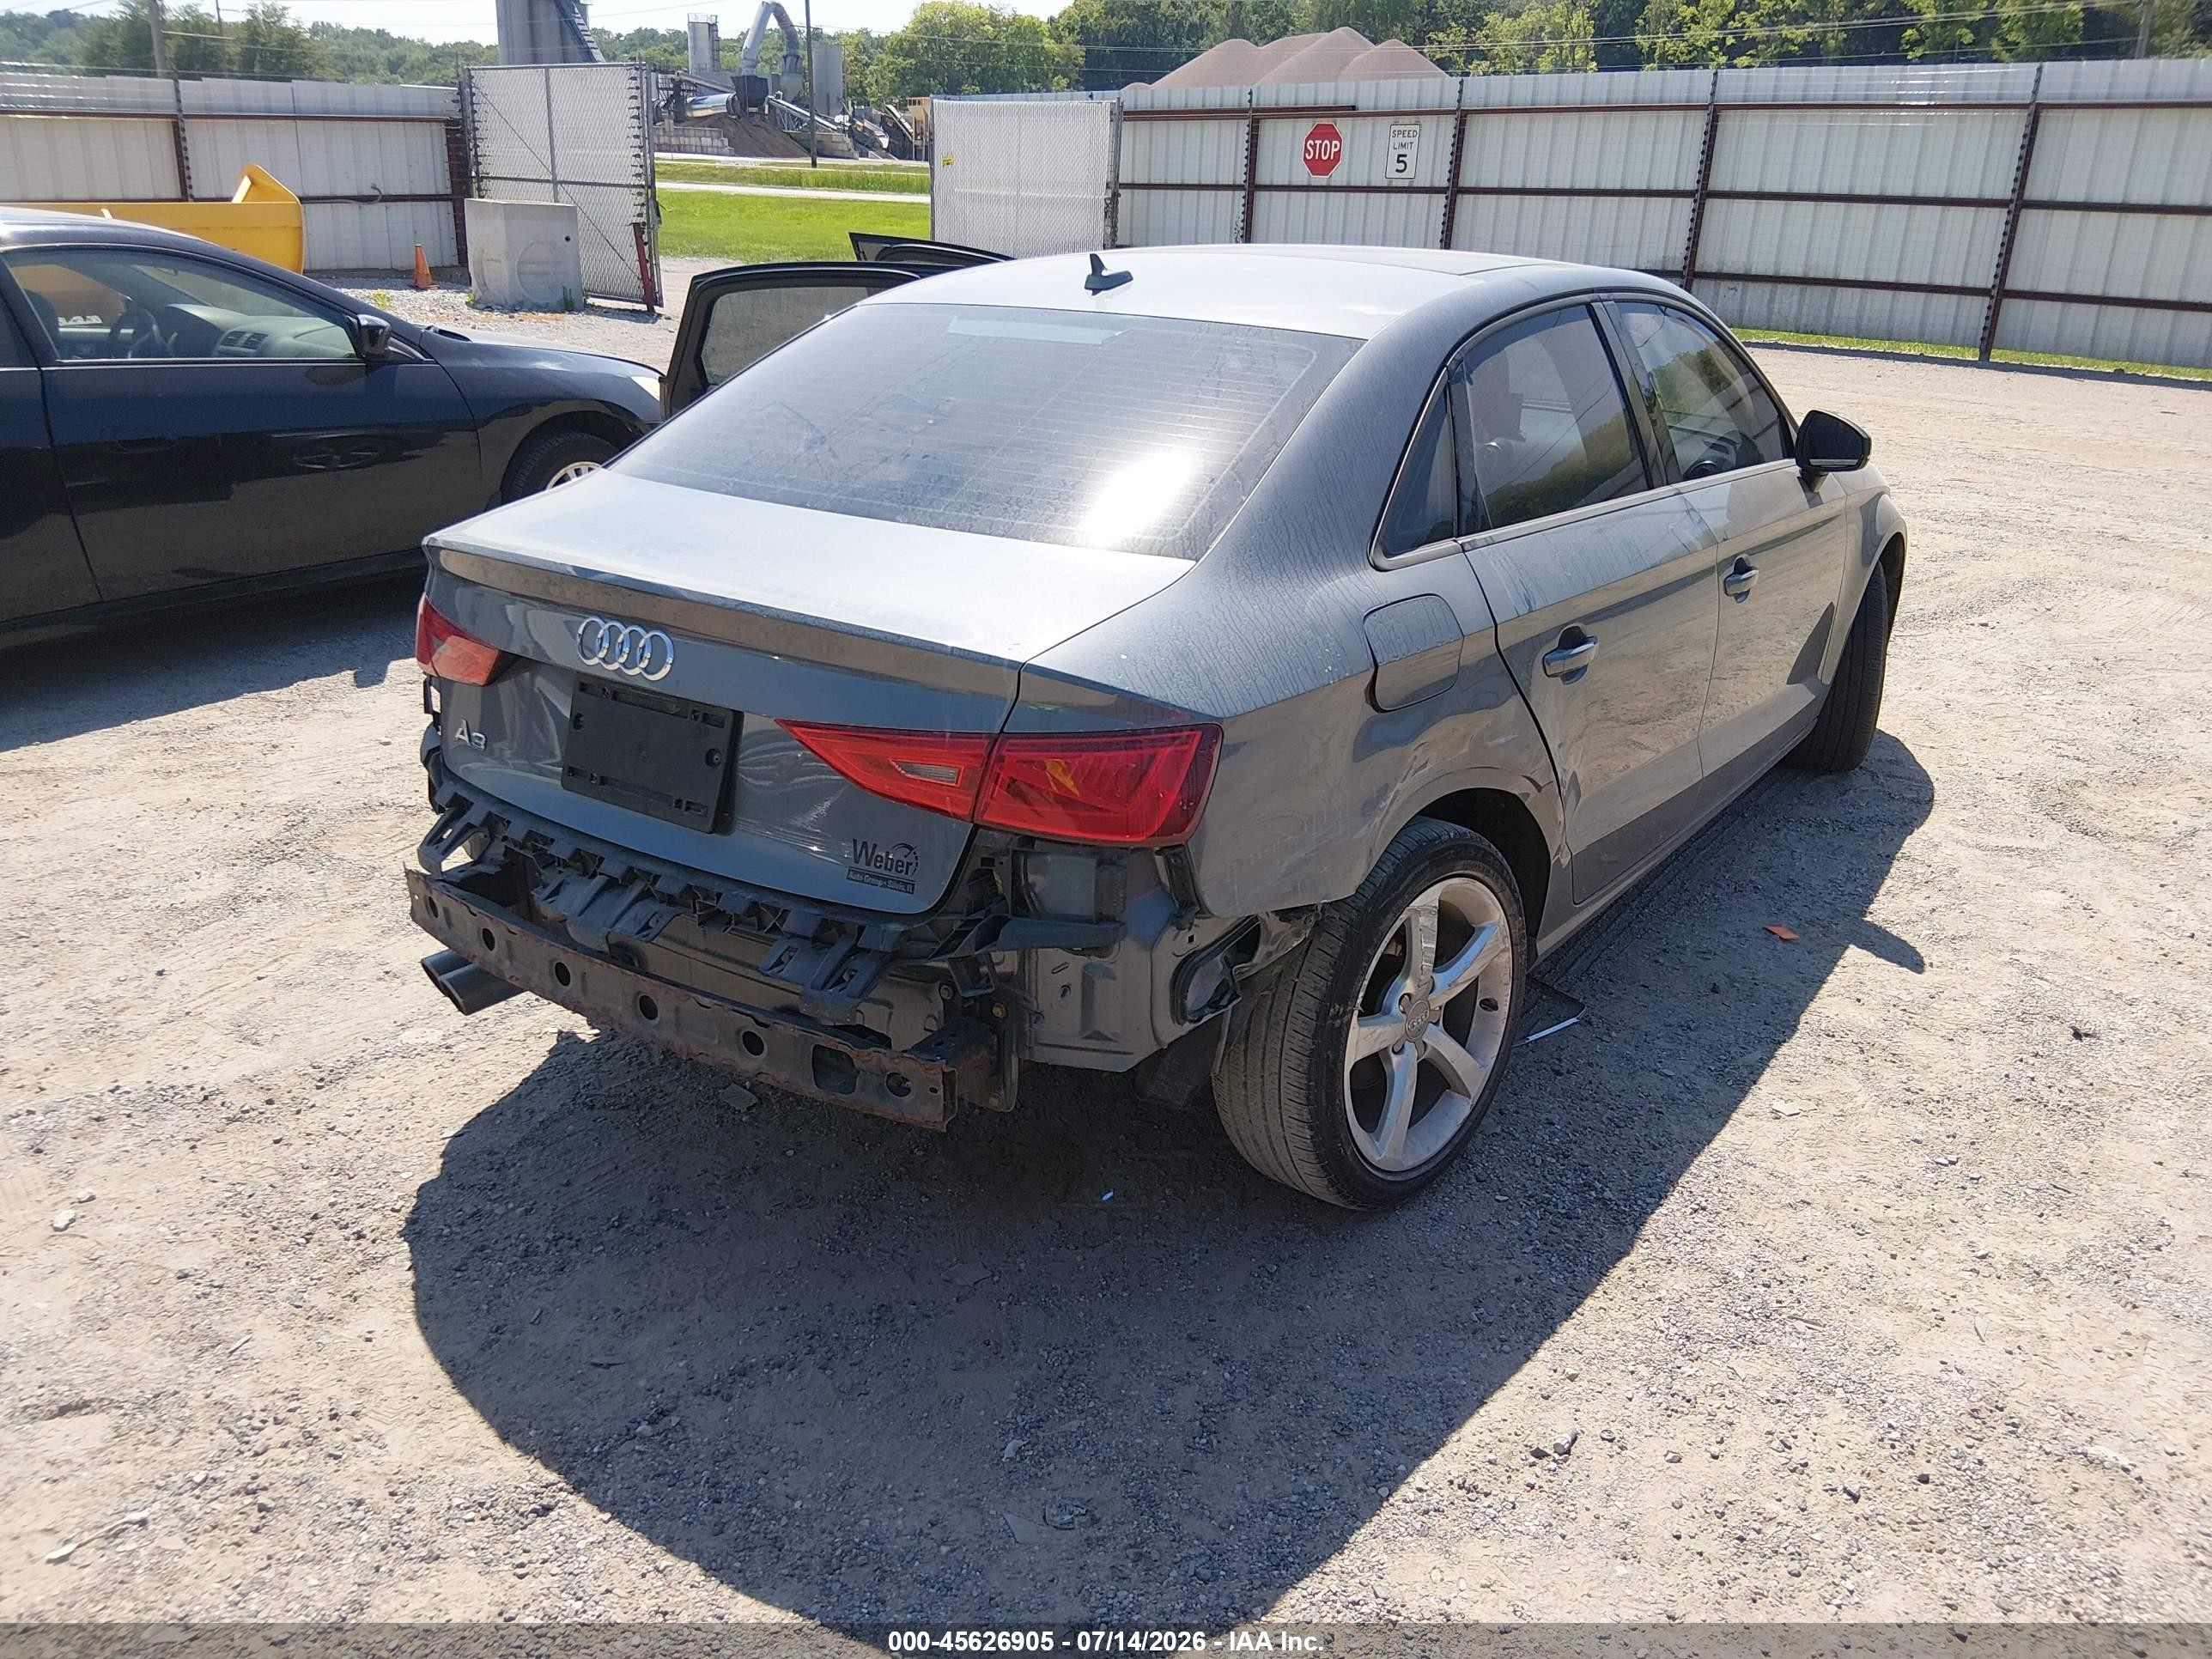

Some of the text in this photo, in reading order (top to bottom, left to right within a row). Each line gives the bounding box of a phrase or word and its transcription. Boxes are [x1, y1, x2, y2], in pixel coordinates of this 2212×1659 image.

[1392, 130, 1418, 138] SPEED
[1305, 140, 1340, 160] STOP
[1393, 142, 1413, 150] LIMIT
[1395, 154, 1407, 173] 5
[454, 718, 486, 750] A3
[853, 838, 913, 875] Weber
